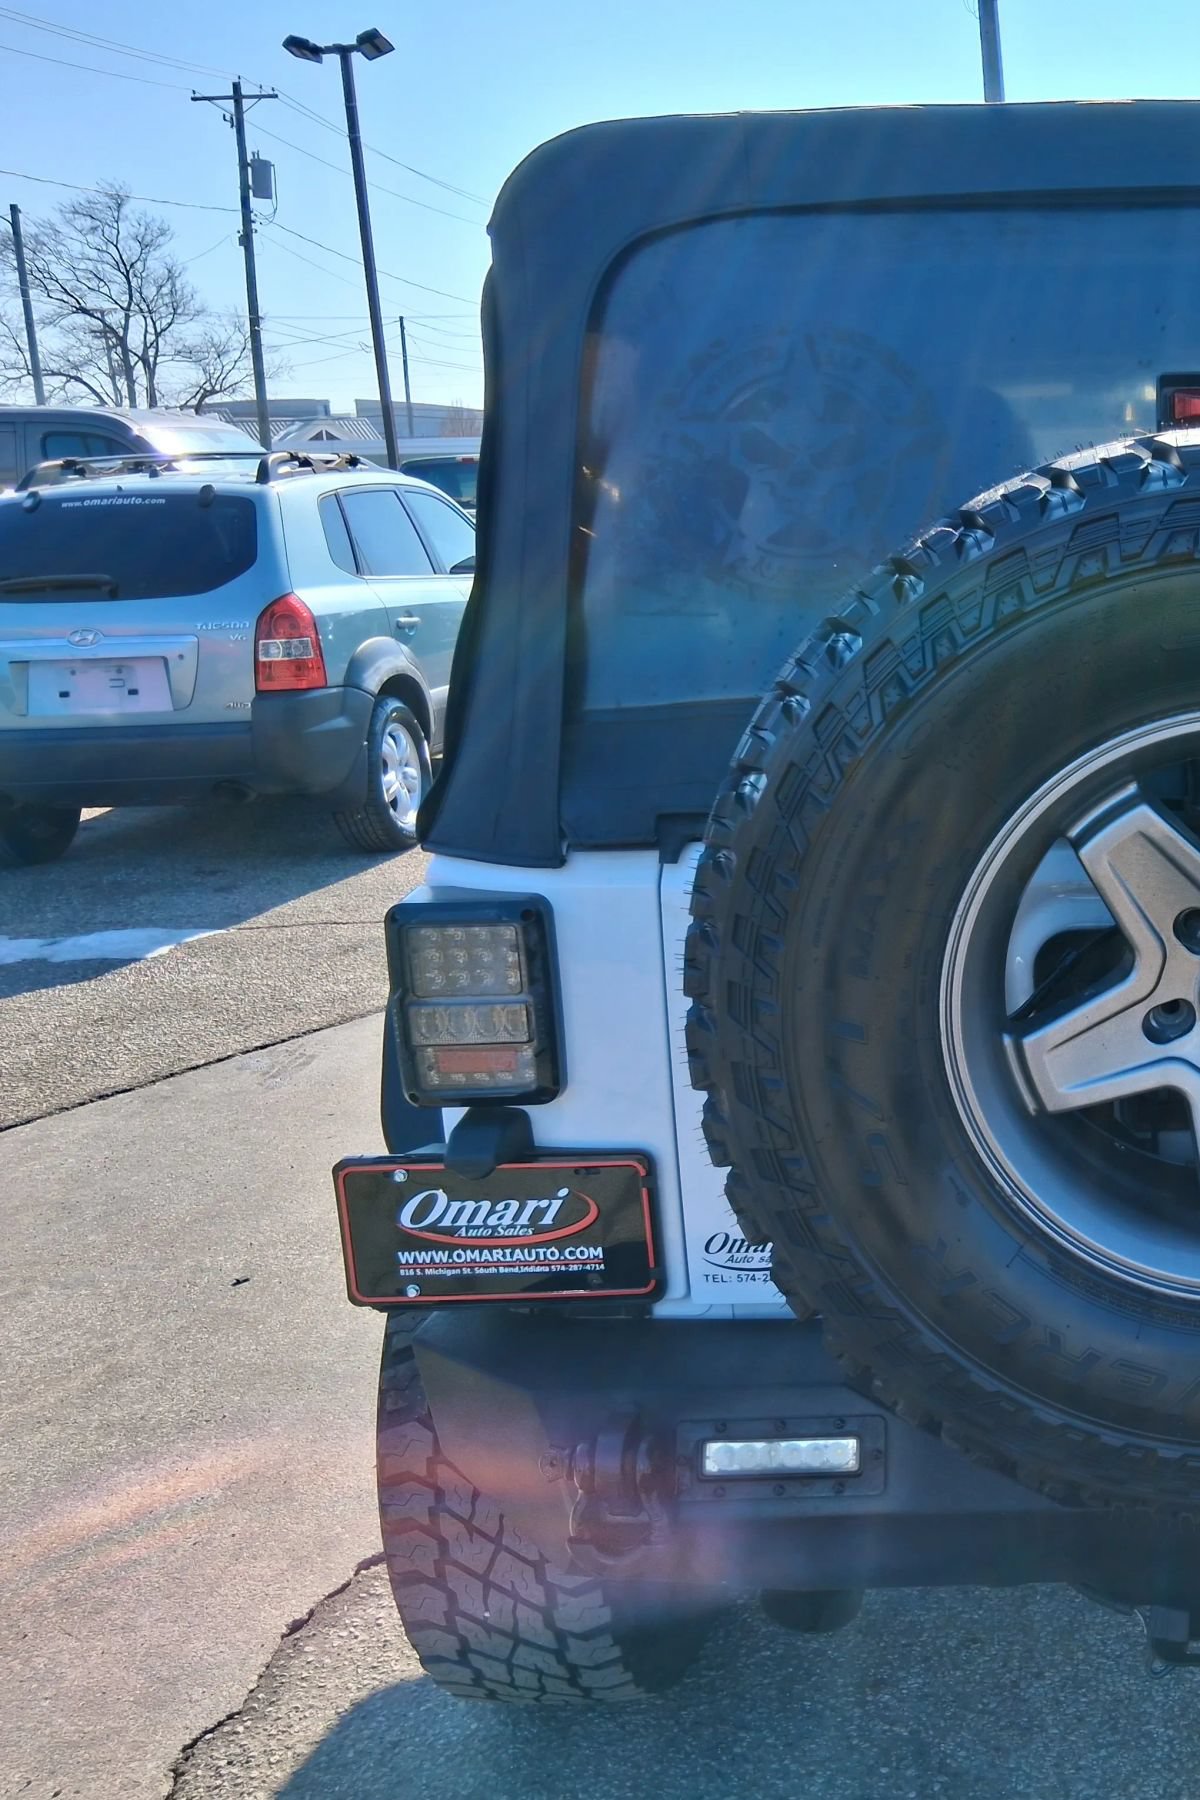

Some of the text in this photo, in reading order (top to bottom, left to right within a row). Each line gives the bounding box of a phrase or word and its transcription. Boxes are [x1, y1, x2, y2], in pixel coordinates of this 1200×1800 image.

[61, 497, 166, 508] www.omariauto.com
[400, 1187, 570, 1229] Omari
[454, 1225, 535, 1237] Auto Sales
[398, 1246, 604, 1265] WWW.OMARIAUTO.COM
[725, 1254, 755, 1264] Auto
[425, 1267, 461, 1276] Michigan
[462, 1267, 473, 1275] St.
[474, 1265, 498, 1275] South
[551, 1262, 605, 1272] 574-287-4714
[703, 1273, 733, 1283] TEL:
